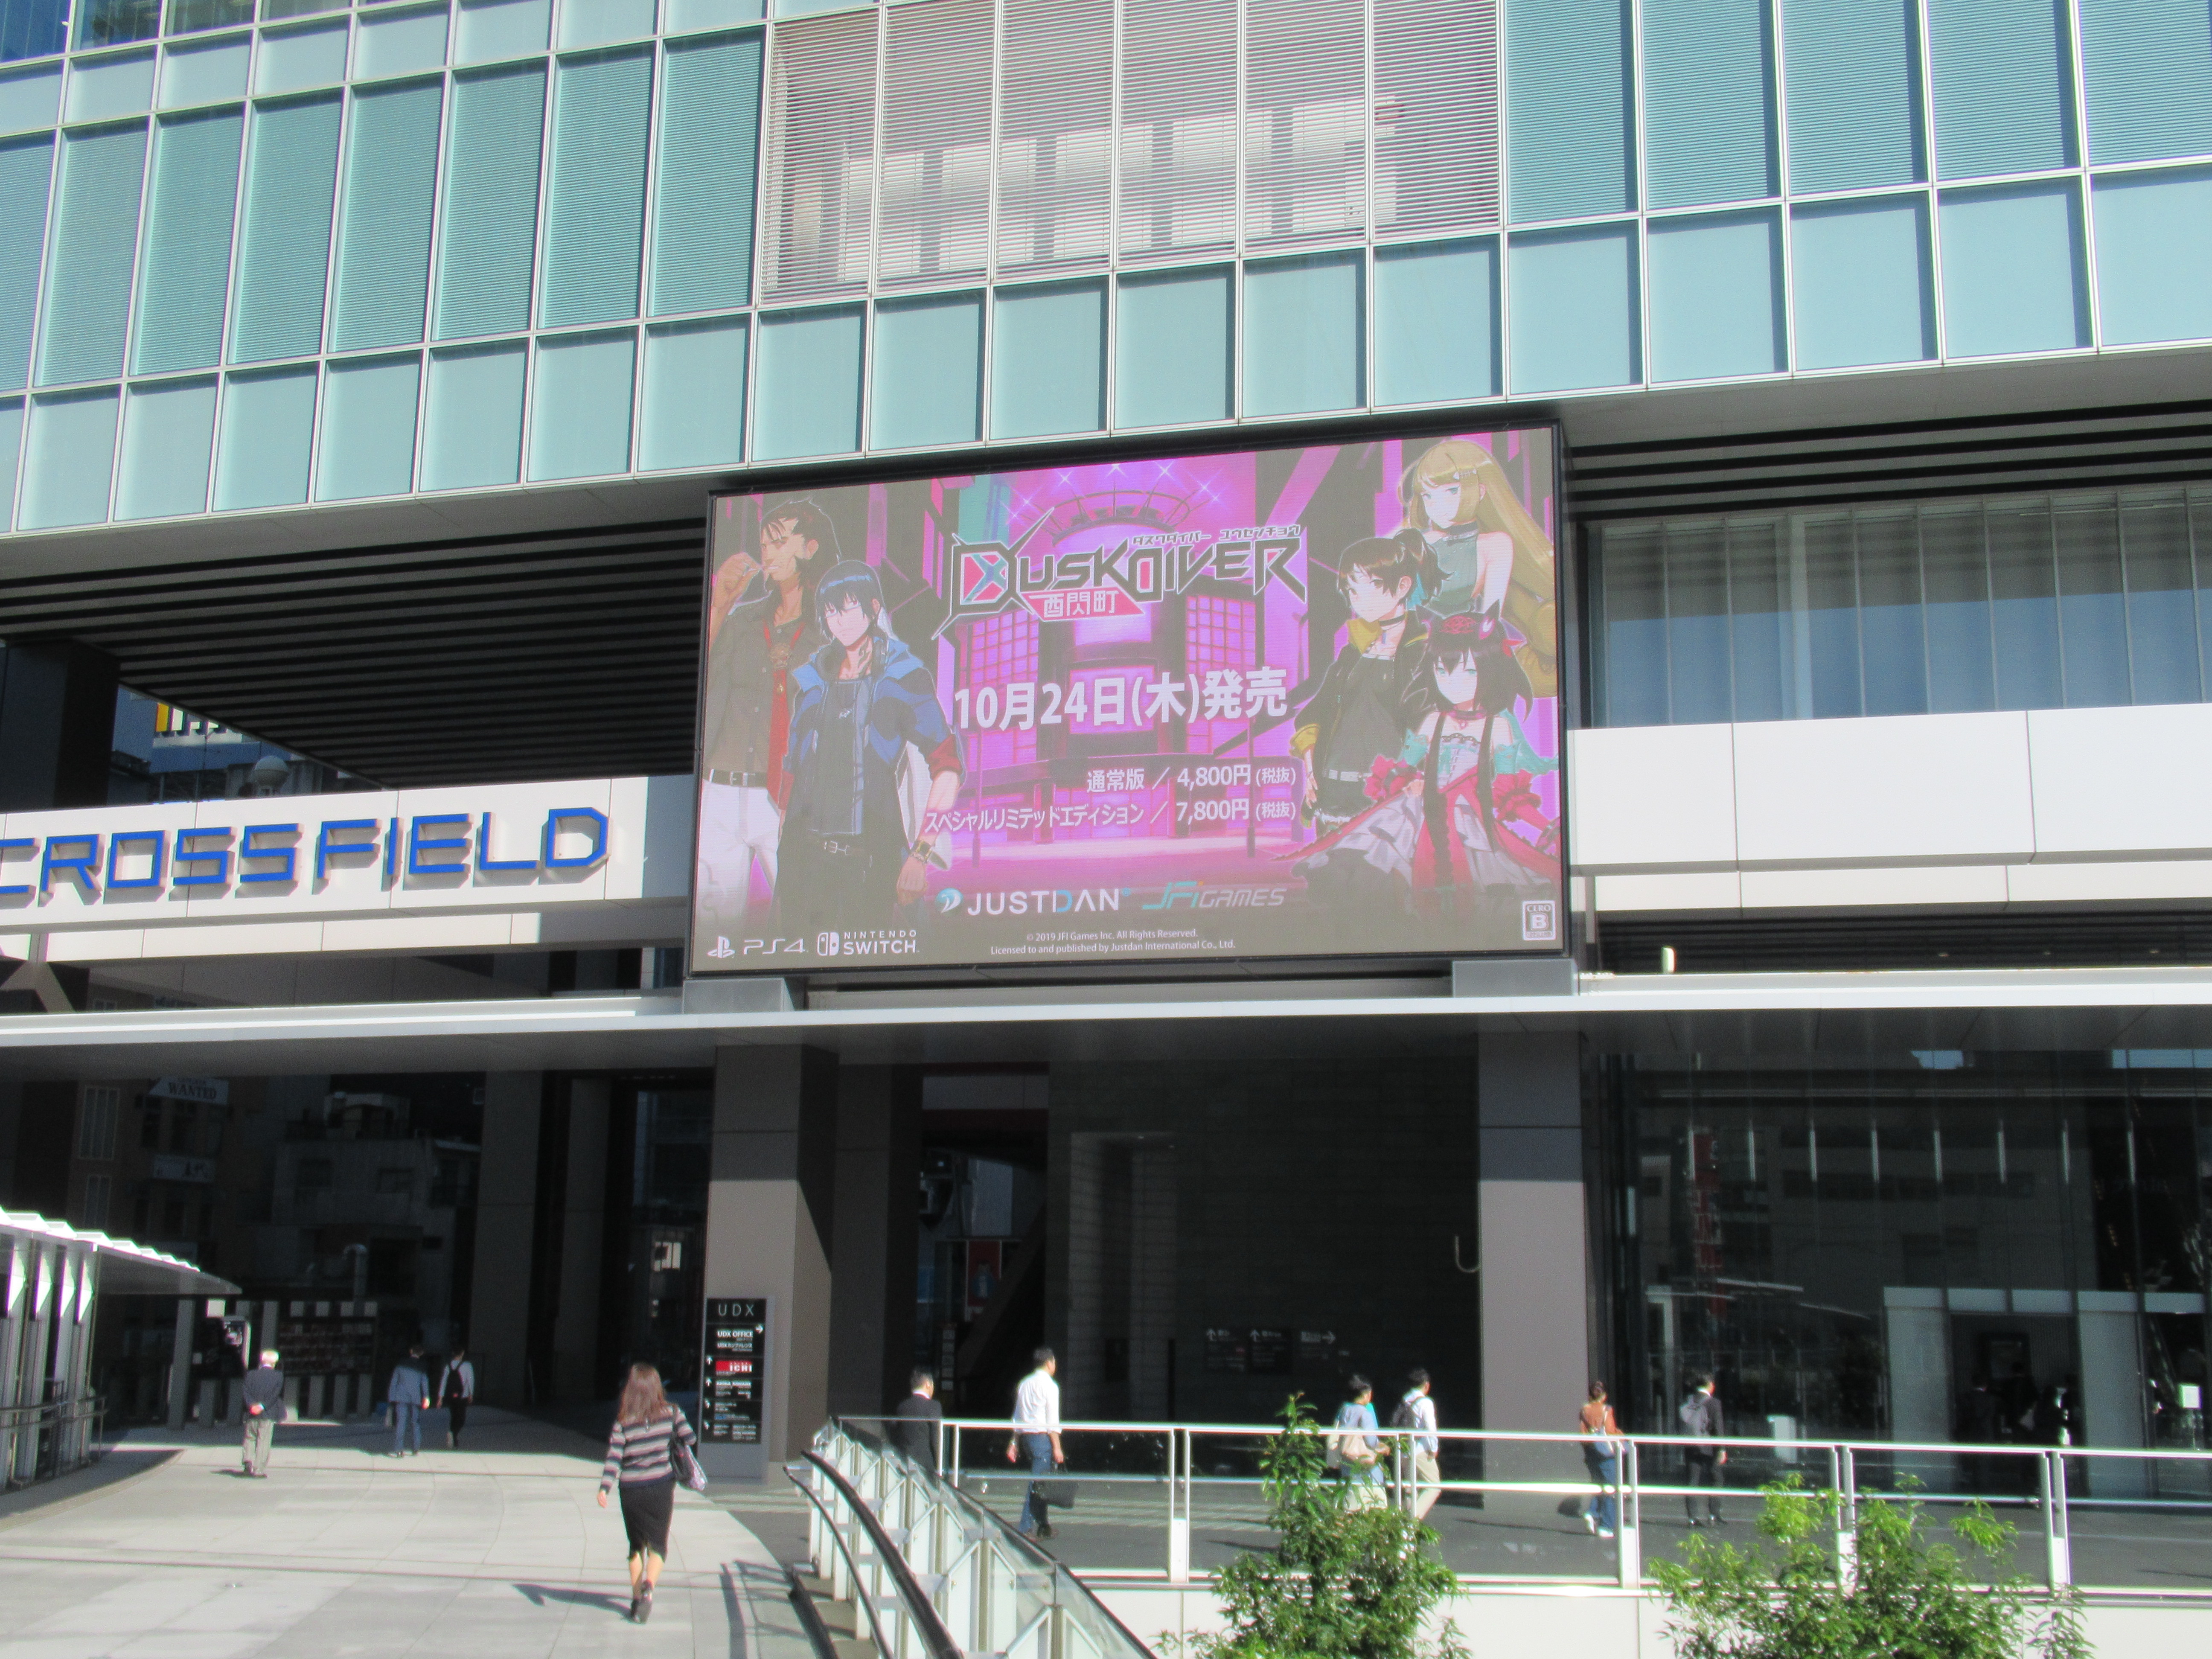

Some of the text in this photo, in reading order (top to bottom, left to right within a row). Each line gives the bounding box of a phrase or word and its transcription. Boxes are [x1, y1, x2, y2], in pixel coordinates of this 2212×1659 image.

[1132, 531, 1211, 546] ダスクダイバー
[955, 667, 1287, 731] 10月24日(木)発売
[1087, 768, 1145, 793] 通常版
[1176, 764, 1251, 791] 4,800円
[1256, 767, 1296, 787] (税抜)
[925, 803, 1144, 833] スペシャルリミテッドエディション
[1176, 798, 1249, 825] 7,800円
[1256, 802, 1296, 821] (税抜)
[967, 888, 1119, 916] JUSTDAN
[1531, 913, 1548, 930] B
[844, 930, 917, 939] NINTENDO
[1036, 932, 1056, 941] 2019
[1057, 932, 1068, 941] JFI
[1070, 931, 1098, 940] Games
[1100, 931, 1115, 939] Inc.
[1117, 930, 1127, 939] All
[1130, 930, 1156, 940] Rights
[1158, 928, 1198, 938] Reserved.
[743, 939, 806, 954] PS4
[844, 940, 917, 955] SWITCH
[991, 945, 1026, 955] Licensed
[1038, 944, 1054, 953] and
[1056, 943, 1097, 955] published
[1099, 943, 1109, 953] by
[1110, 942, 1143, 952] Justdan
[1146, 940, 1199, 950] International
[1202, 940, 1217, 950] Co.,
[1220, 939, 1236, 949] Ltd.
[168, 1082, 217, 1100] WANTED
[718, 1304, 754, 1317] UDX
[717, 1329, 753, 1338] UDX OFFICE
